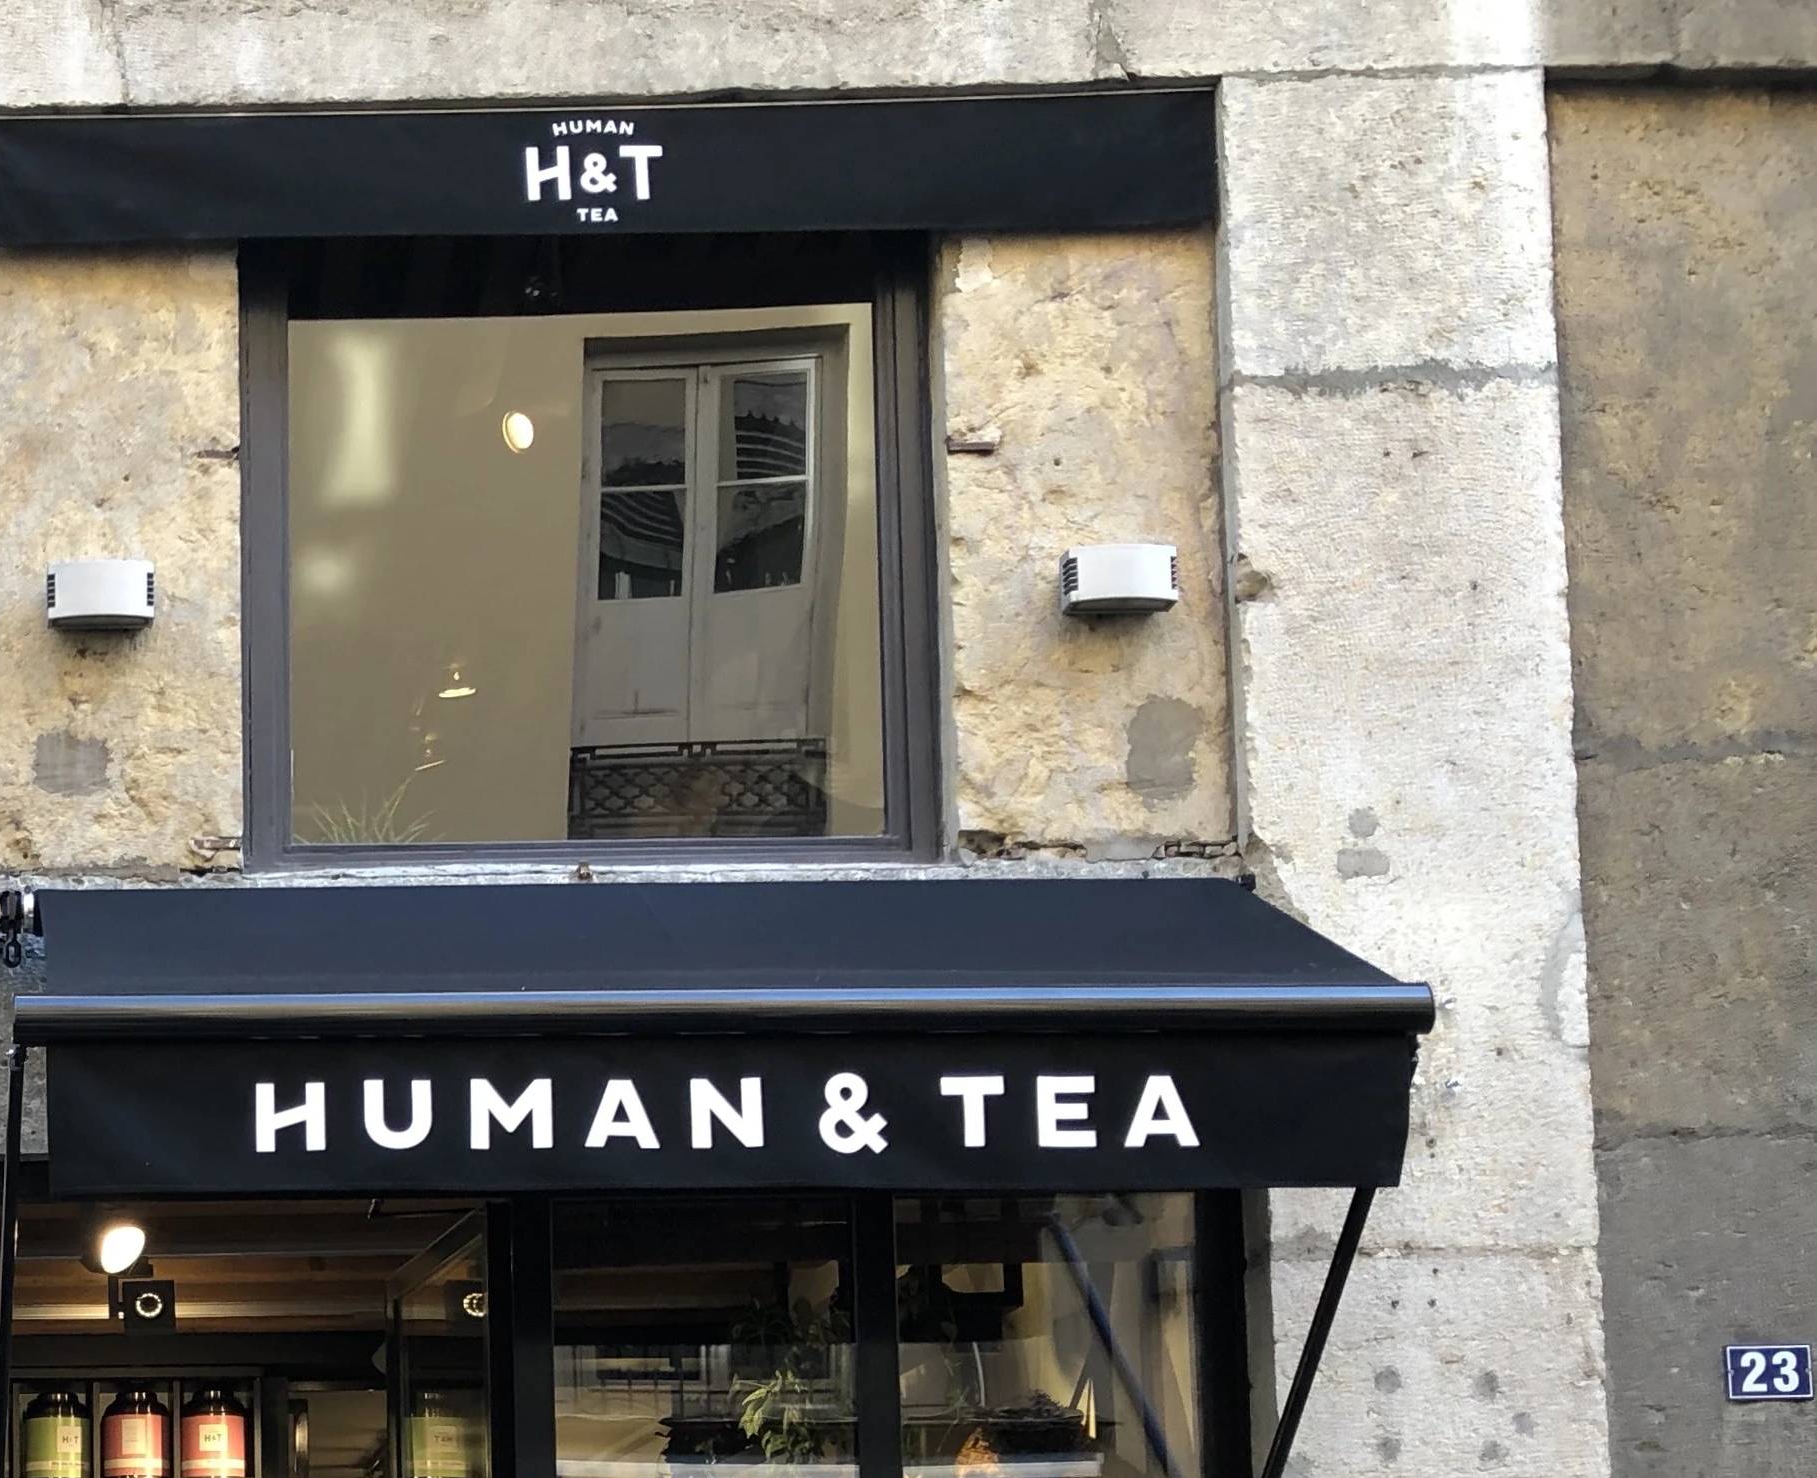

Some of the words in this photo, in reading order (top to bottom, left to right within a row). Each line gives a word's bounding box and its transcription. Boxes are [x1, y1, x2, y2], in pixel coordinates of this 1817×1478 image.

[551, 119, 635, 137] HUMAN
[524, 144, 663, 202] H&T
[576, 207, 619, 222] TEA
[255, 1076, 764, 1153] HUMAN
[818, 1072, 889, 1154] &
[939, 1074, 1200, 1148] TEA
[1740, 1350, 1800, 1393] 23
